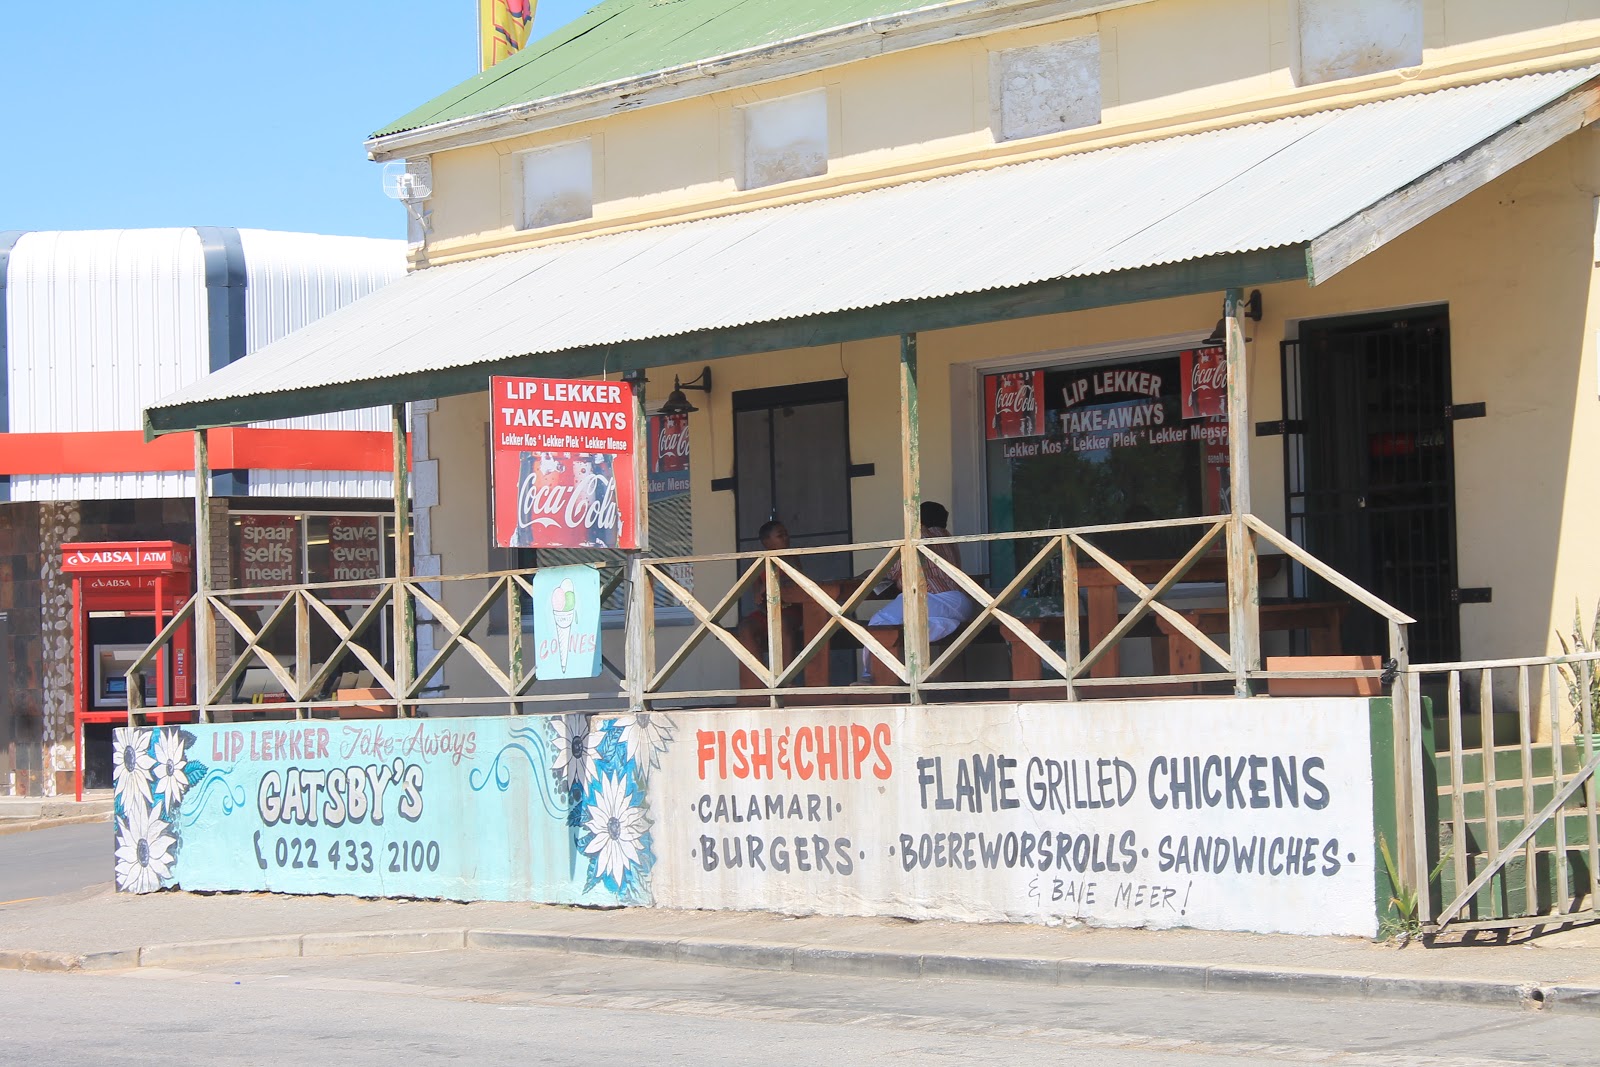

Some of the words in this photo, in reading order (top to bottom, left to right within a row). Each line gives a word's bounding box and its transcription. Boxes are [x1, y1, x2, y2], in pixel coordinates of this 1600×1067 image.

[1191, 359, 1227, 392] Coca-Co
[507, 381, 538, 400] LIP
[543, 383, 621, 404] LEKKER
[995, 384, 1035, 415] Coca-Cola
[1062, 378, 1089, 408] LIP
[1093, 371, 1162, 398] LEKKER
[501, 407, 627, 430] TAKE-AWAYS
[1060, 403, 1164, 434] TAKE-AWAYS
[501, 432, 523, 446] Lekker
[524, 433, 537, 447] Kos
[543, 434, 565, 447] Lekker
[566, 435, 580, 448] Plek
[585, 436, 606, 449] Lekker
[607, 437, 627, 451] Mense
[658, 425, 690, 459] Coca-Co
[1003, 441, 1039, 459] Lekker
[1041, 438, 1062, 455] Kos
[1073, 435, 1110, 452] Lekker
[1113, 432, 1137, 448] Plek
[1149, 427, 1188, 445] Lekker
[1190, 424, 1228, 442] Mense
[648, 480, 666, 492] kker
[667, 477, 690, 491] Mens
[518, 472, 617, 530] Coca-Cola
[243, 526, 294, 543] spaar
[332, 526, 377, 541] save
[91, 551, 133, 563] ABSA
[143, 552, 167, 562] ATM
[244, 543, 293, 562] selfs
[333, 546, 378, 562] even
[106, 579, 131, 587] ABSA
[245, 564, 293, 581] meer!
[333, 564, 380, 580] more!
[540, 633, 596, 660] CONES
[212, 730, 244, 762] LIP
[250, 727, 330, 762] LEKKER
[339, 722, 477, 767] Take-Aways
[257, 756, 424, 828] GATSBY'S
[917, 753, 1020, 813] FLAME
[1025, 755, 1137, 815] GRILLED
[1148, 754, 1330, 811] CHICKENS
[275, 836, 319, 869] 022
[328, 839, 374, 874] 433
[387, 840, 440, 874] 2100
[1028, 873, 1041, 908] &
[1051, 875, 1097, 905] BAIE
[1114, 880, 1192, 916] MEER!
